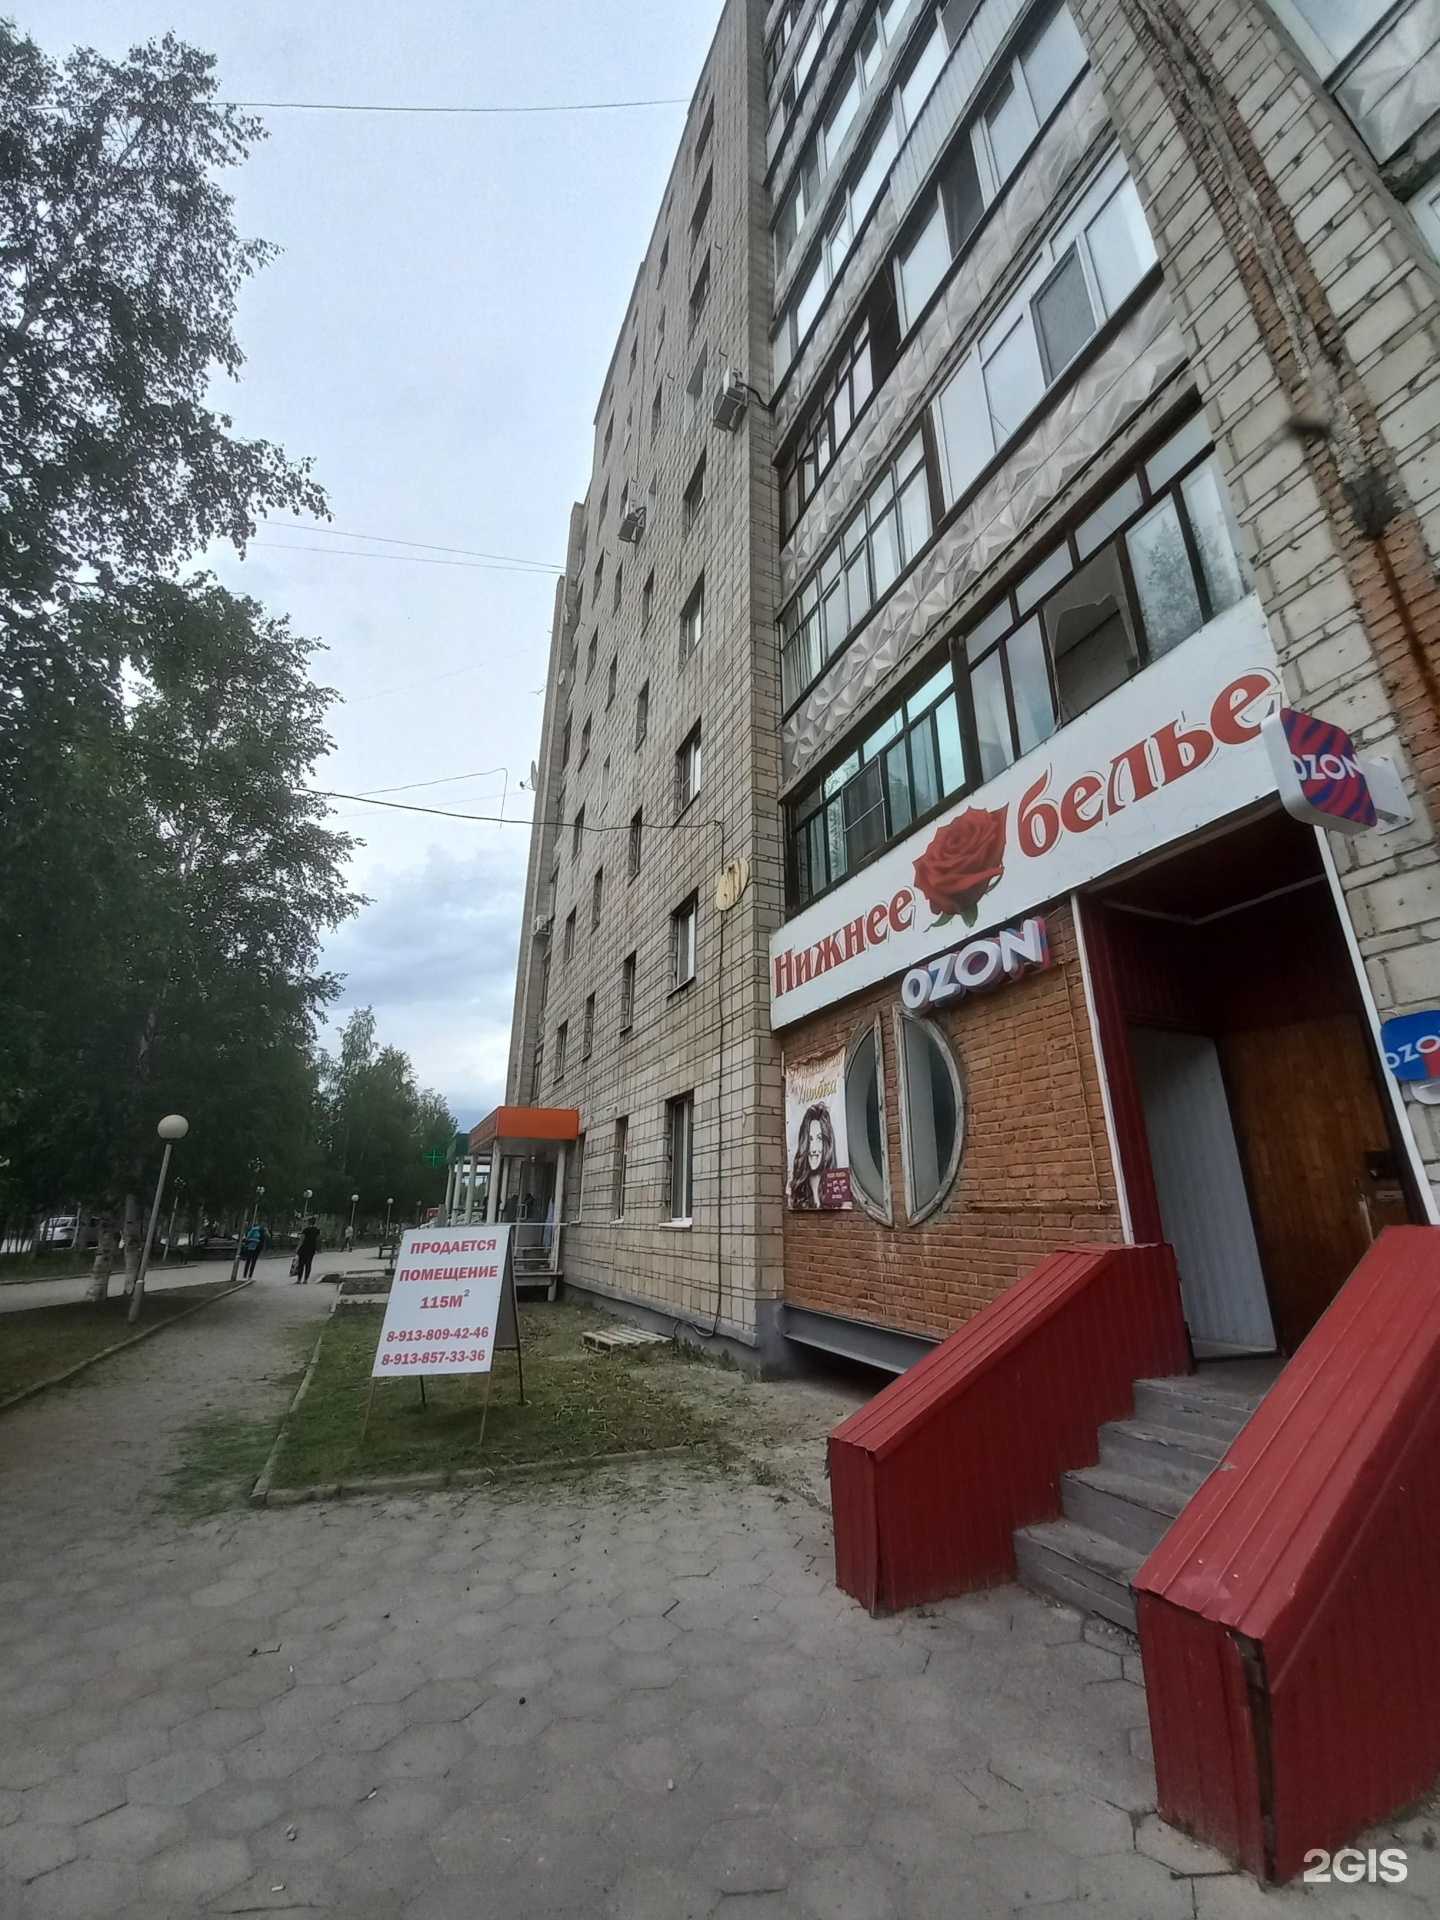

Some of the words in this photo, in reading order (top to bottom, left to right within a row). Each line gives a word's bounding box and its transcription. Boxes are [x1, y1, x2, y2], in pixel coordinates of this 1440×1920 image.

[773, 885, 915, 998] Нижнее
[1017, 667, 1279, 858] белье
[901, 917, 1048, 1010] OZON
[1385, 1031, 1440, 1069] OZO
[410, 1239, 497, 1255] ПРОДАЕТСЯ
[399, 1265, 498, 1282] ПОМЕЩЕНИЕ
[386, 1326, 489, 1343] 8-913-809-42-46
[382, 1349, 486, 1366] 8-913-857-33-36
